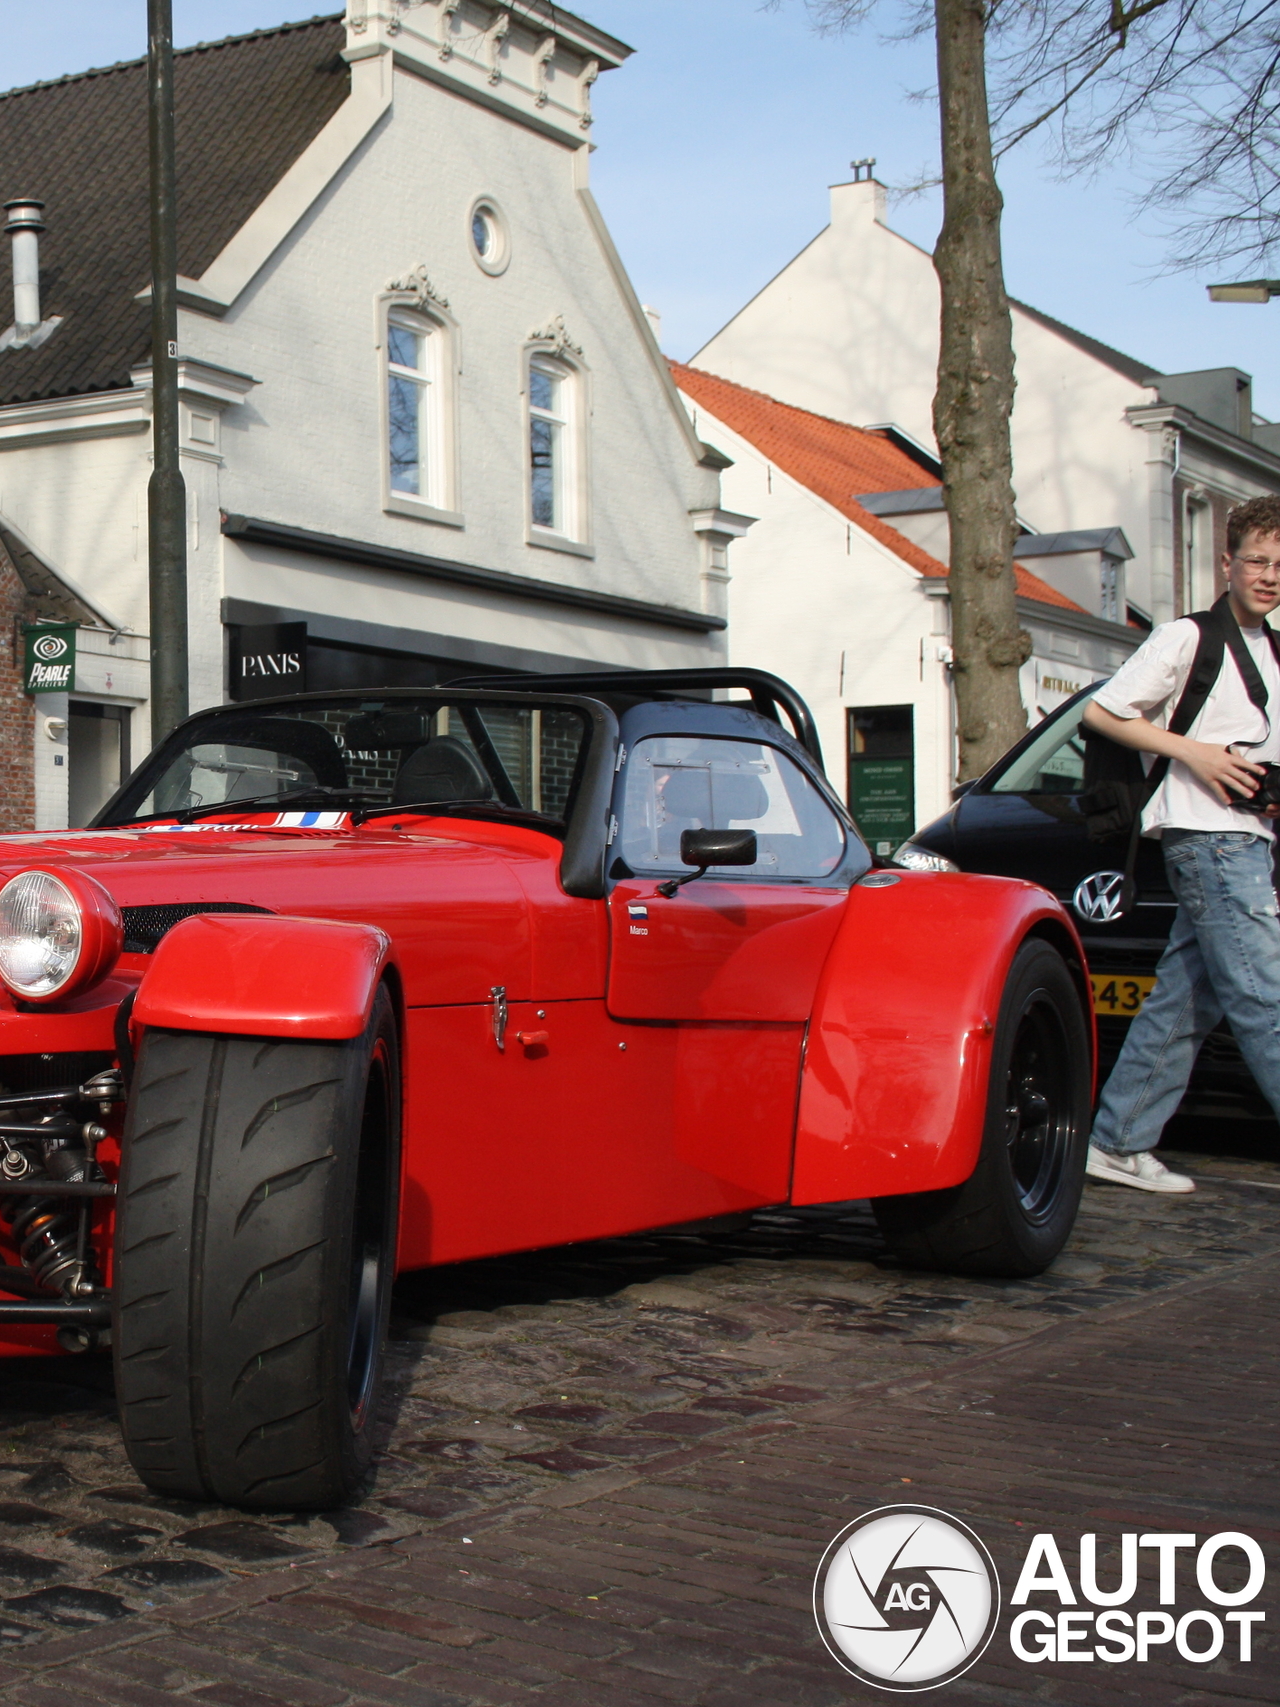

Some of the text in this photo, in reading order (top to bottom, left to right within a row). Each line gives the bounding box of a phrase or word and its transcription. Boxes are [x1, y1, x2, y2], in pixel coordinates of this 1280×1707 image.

[169, 342, 176, 356] 3
[241, 652, 301, 677] PANIS
[29, 662, 72, 682] PEARLE
[27, 680, 67, 688] OPTICIENS
[629, 925, 649, 936] Marco
